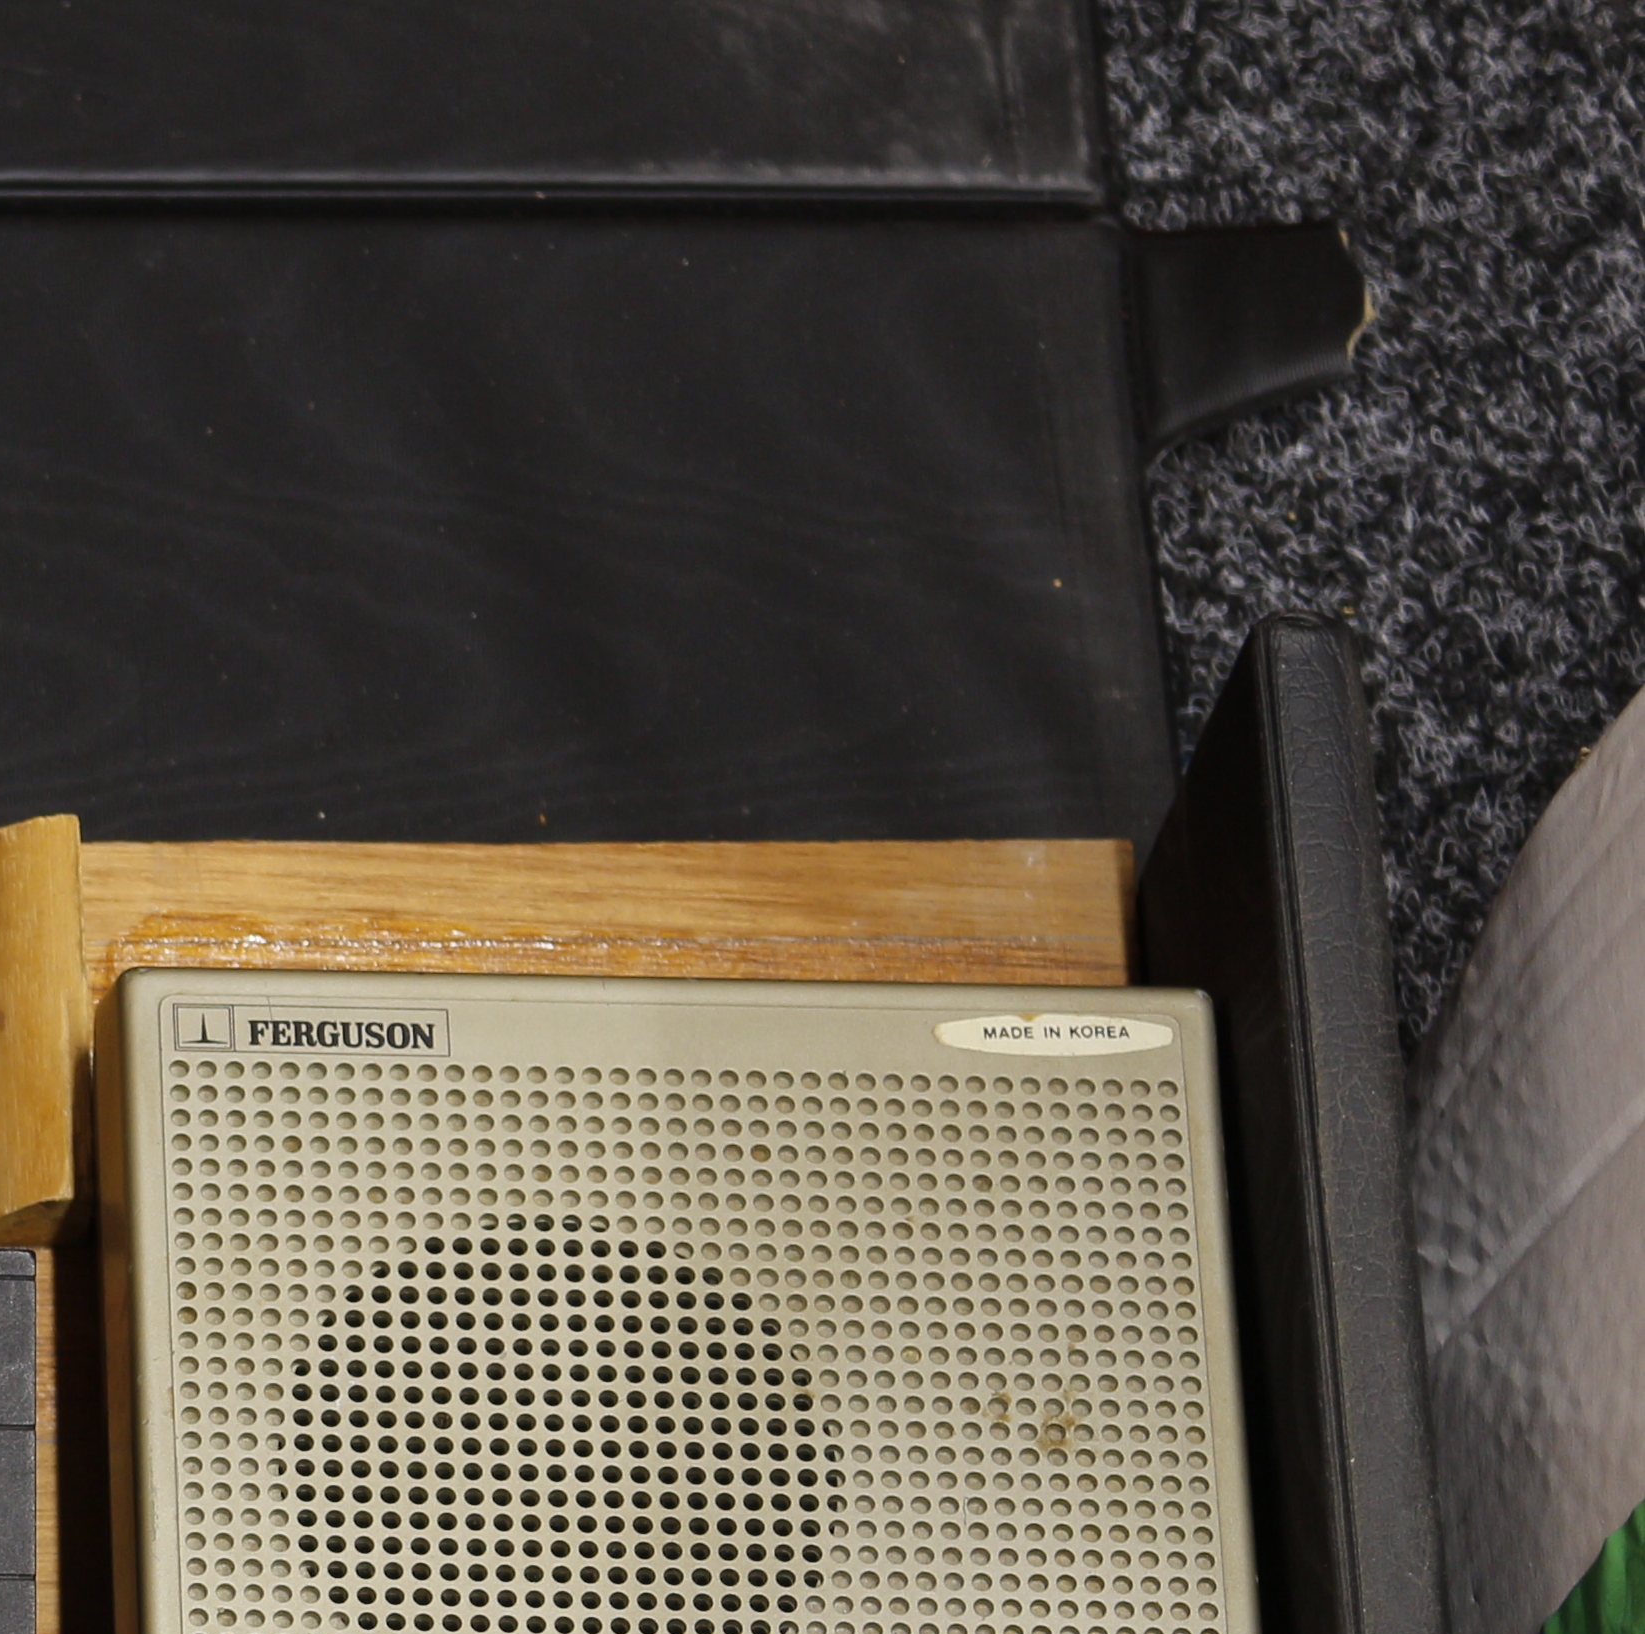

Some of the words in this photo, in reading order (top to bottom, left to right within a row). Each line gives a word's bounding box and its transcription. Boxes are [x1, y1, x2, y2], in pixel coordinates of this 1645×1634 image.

[248, 1020, 435, 1050] FERGUSON
[983, 1026, 1034, 1040] MADE
[1039, 1023, 1061, 1038] IN
[1069, 1025, 1130, 1039] KOREA
